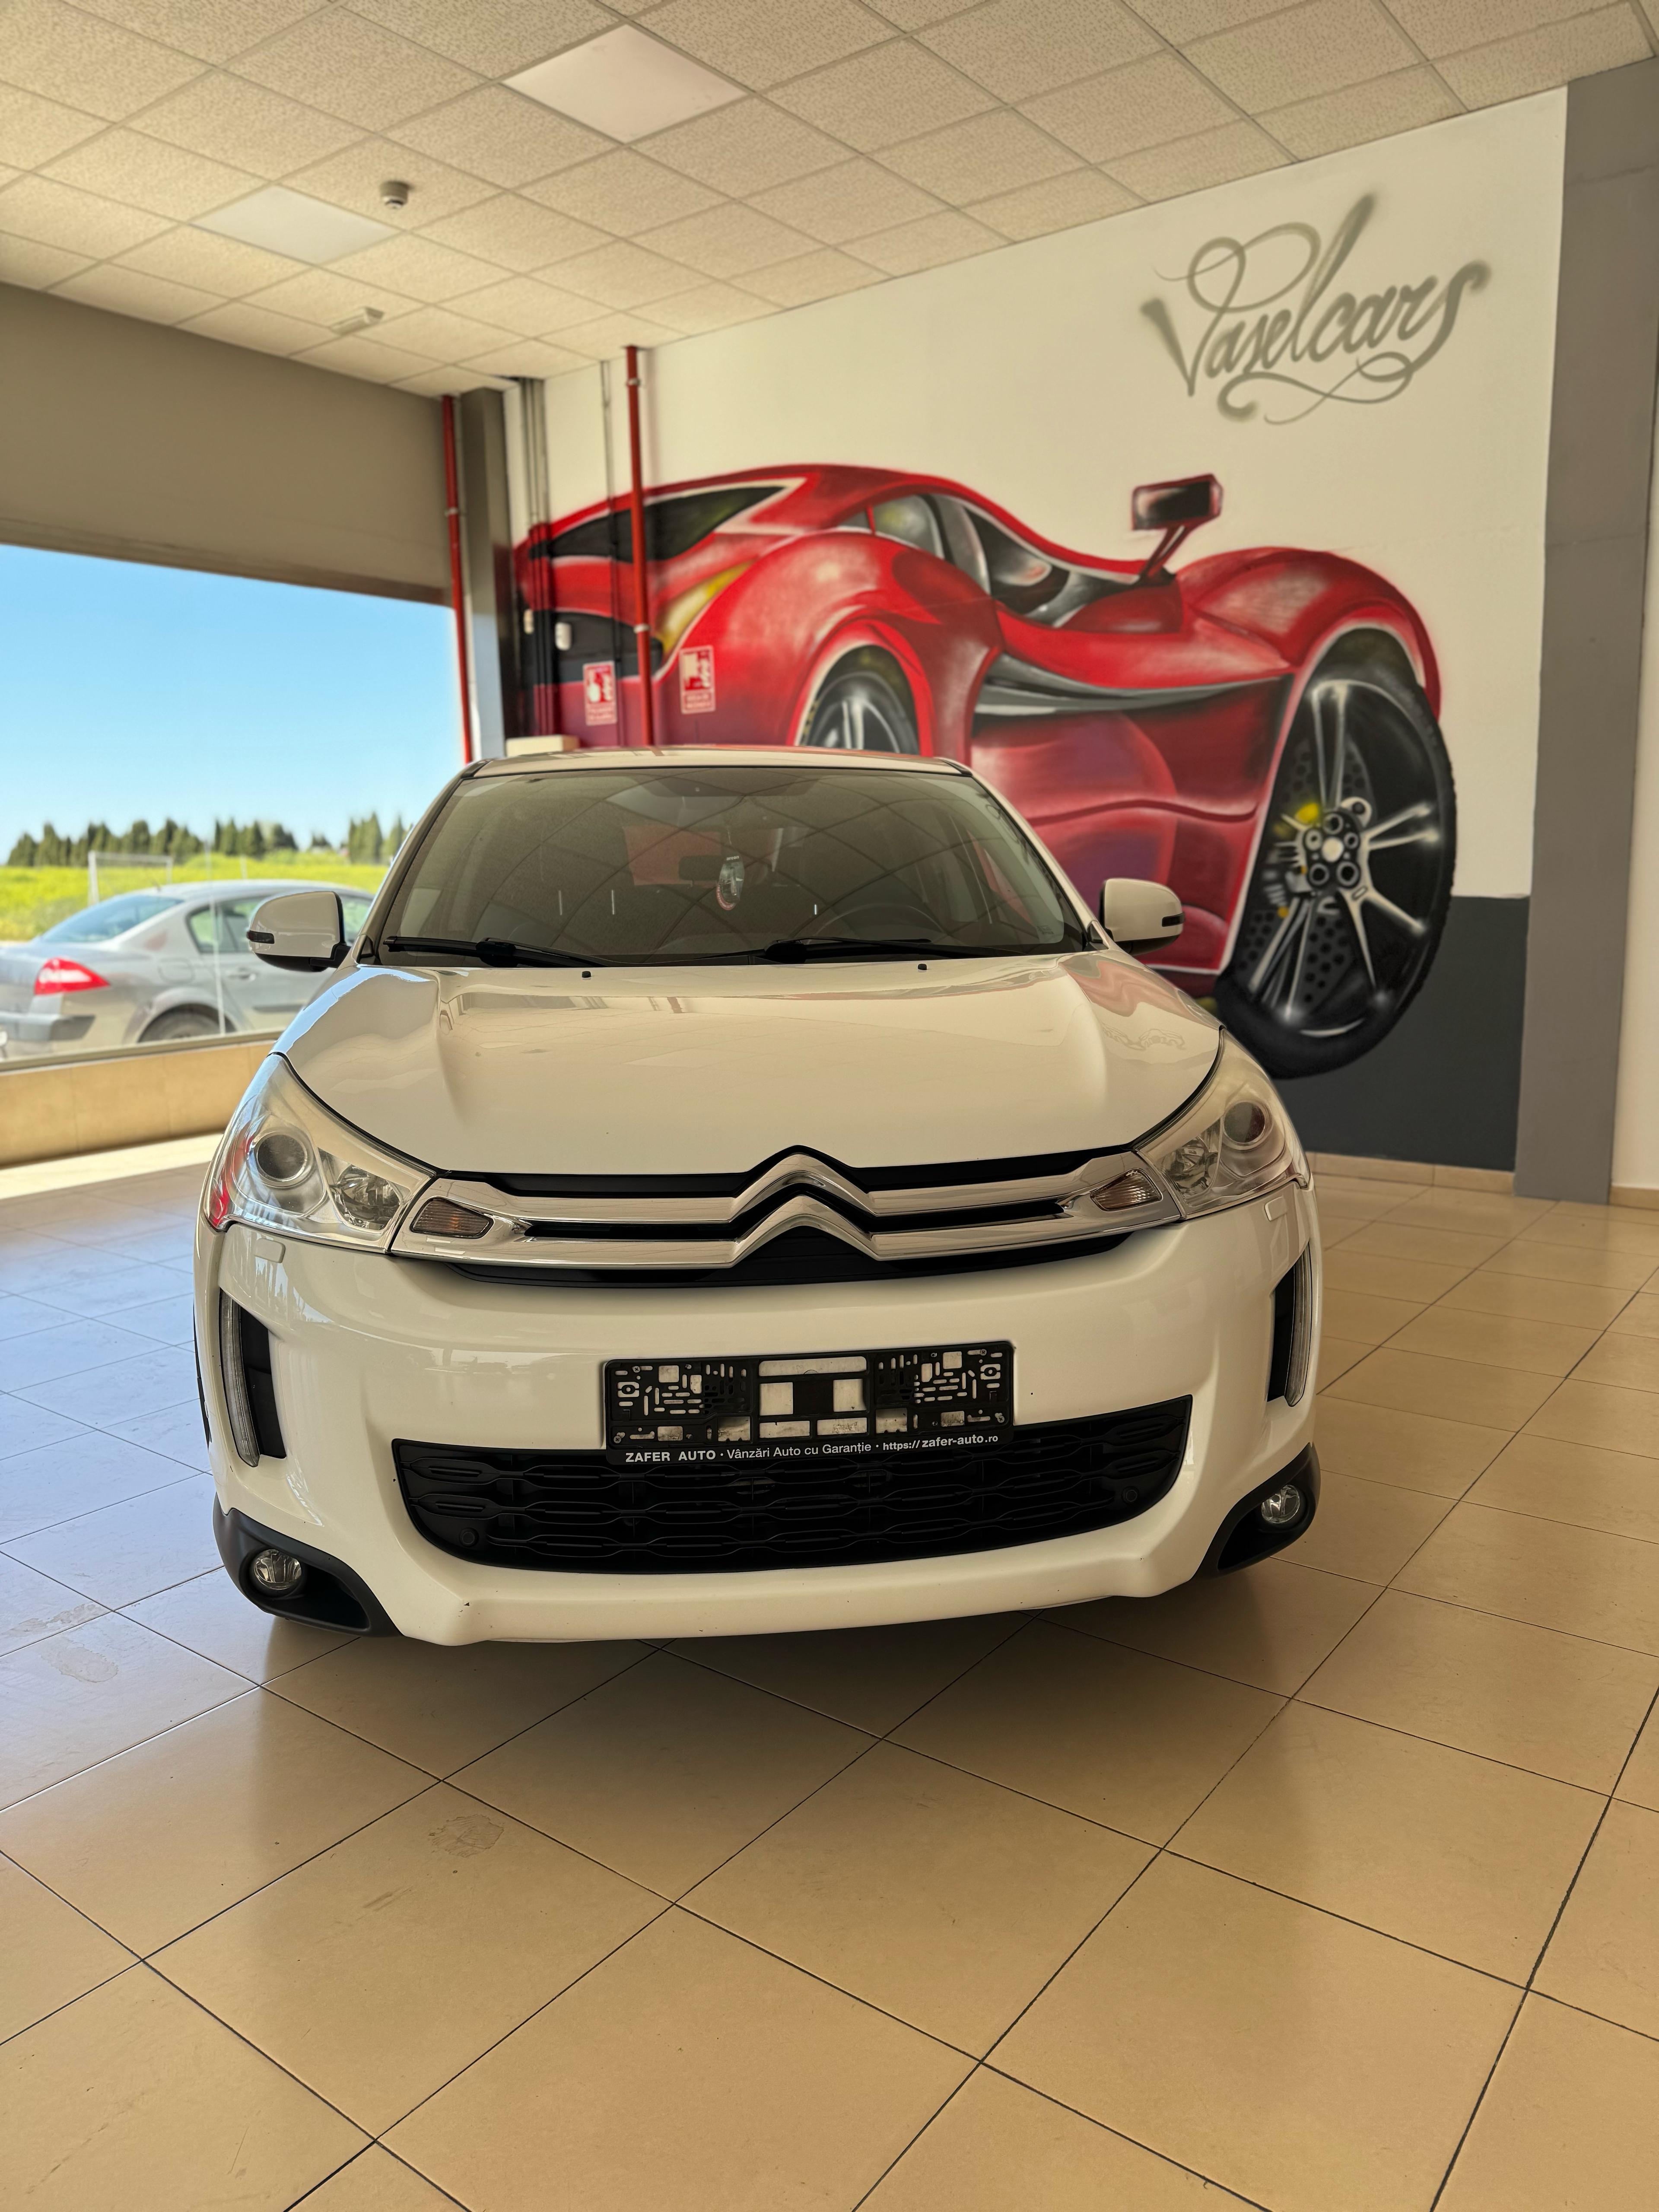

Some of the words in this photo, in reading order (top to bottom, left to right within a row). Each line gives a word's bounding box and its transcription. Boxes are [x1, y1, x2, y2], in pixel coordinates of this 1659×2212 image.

[626, 1452, 670, 1462] ZAFER
[678, 1450, 716, 1461] AUTO
[726, 1447, 770, 1459] Vânzări
[773, 1447, 801, 1457] Auto
[804, 1447, 818, 1455] cu
